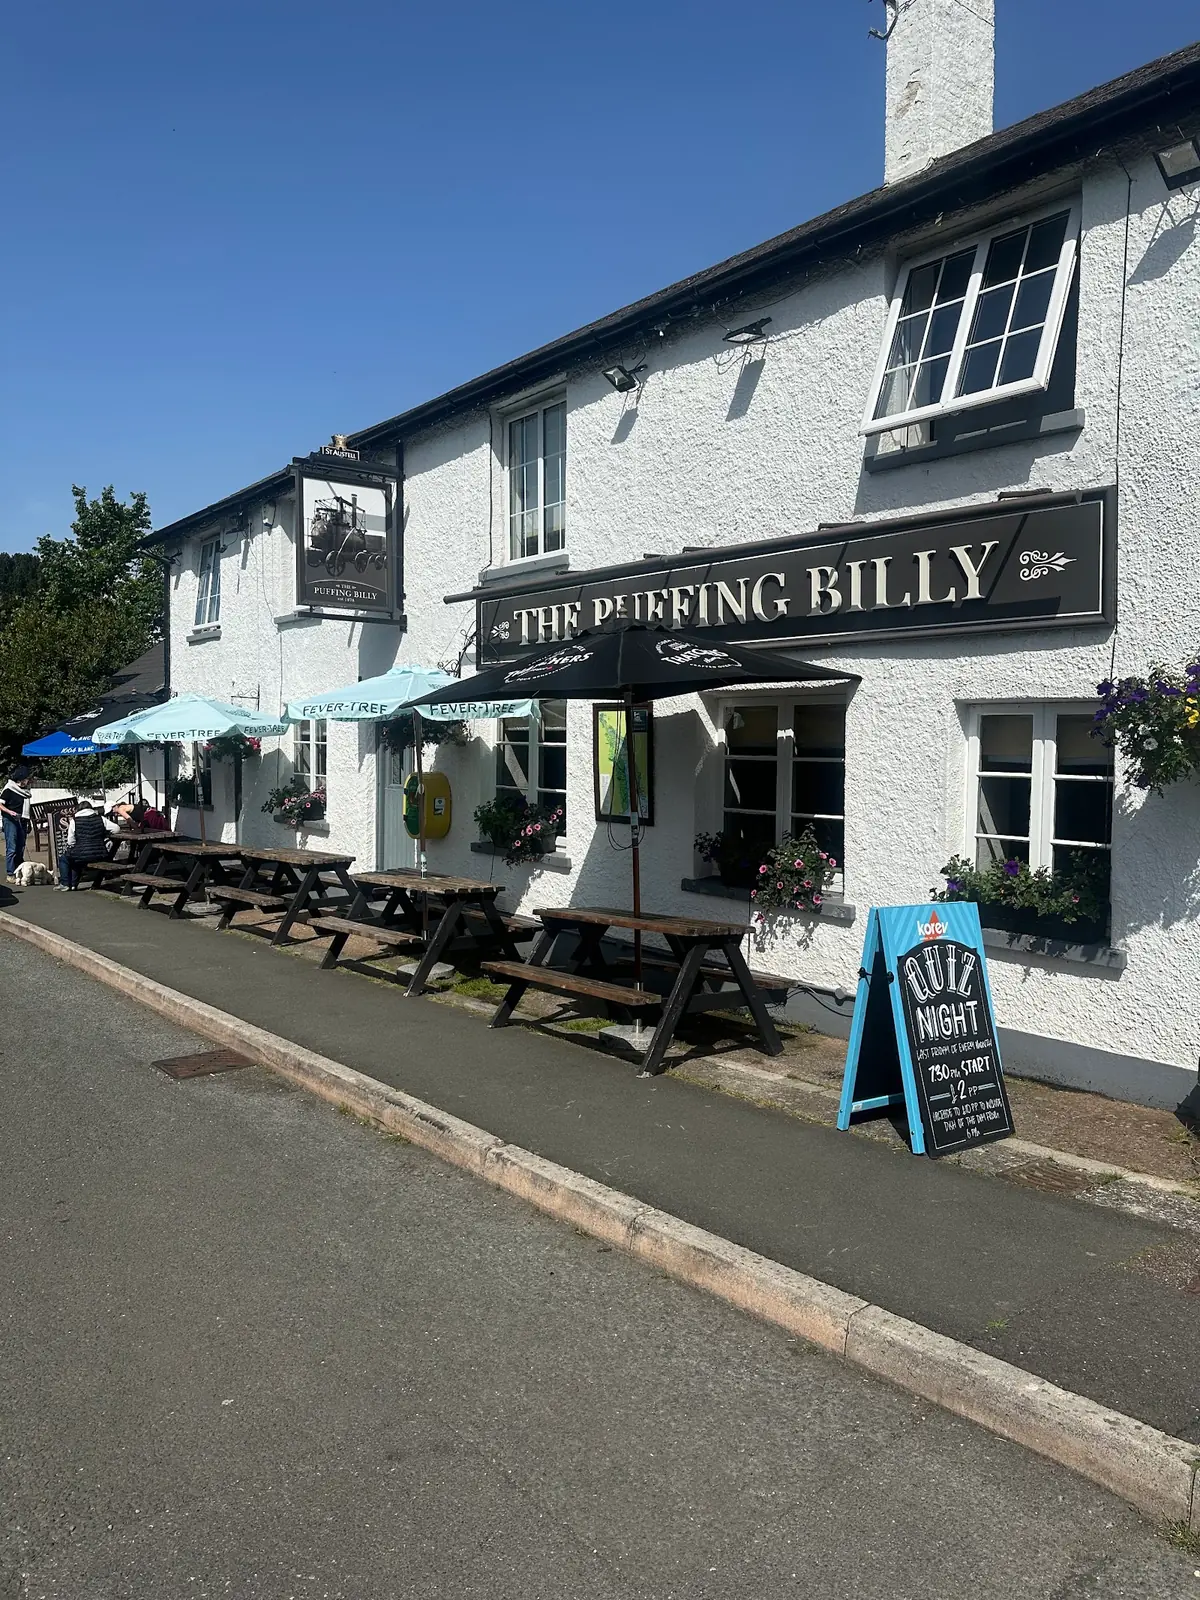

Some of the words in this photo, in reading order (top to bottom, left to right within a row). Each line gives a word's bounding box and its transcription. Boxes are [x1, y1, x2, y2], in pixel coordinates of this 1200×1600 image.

[333, 450, 357, 459] AUSTELL
[314, 587, 352, 597] PUFFING
[354, 591, 378, 600] BILLY
[514, 601, 582, 646] THE
[806, 540, 1000, 617] BILLY
[430, 702, 516, 716] FEVER-TREE
[244, 724, 285, 734] FEVER-TREE
[917, 920, 949, 936] korev
[903, 944, 976, 1003] QUIZ
[916, 1000, 978, 1043] NIGHT
[916, 1048, 929, 1061] LAST
[931, 1045, 951, 1058] FRIDAY
[950, 1043, 958, 1054] OF
[958, 1041, 975, 1053] EVERY
[961, 1055, 990, 1076] START
[965, 1115, 976, 1126] THE
